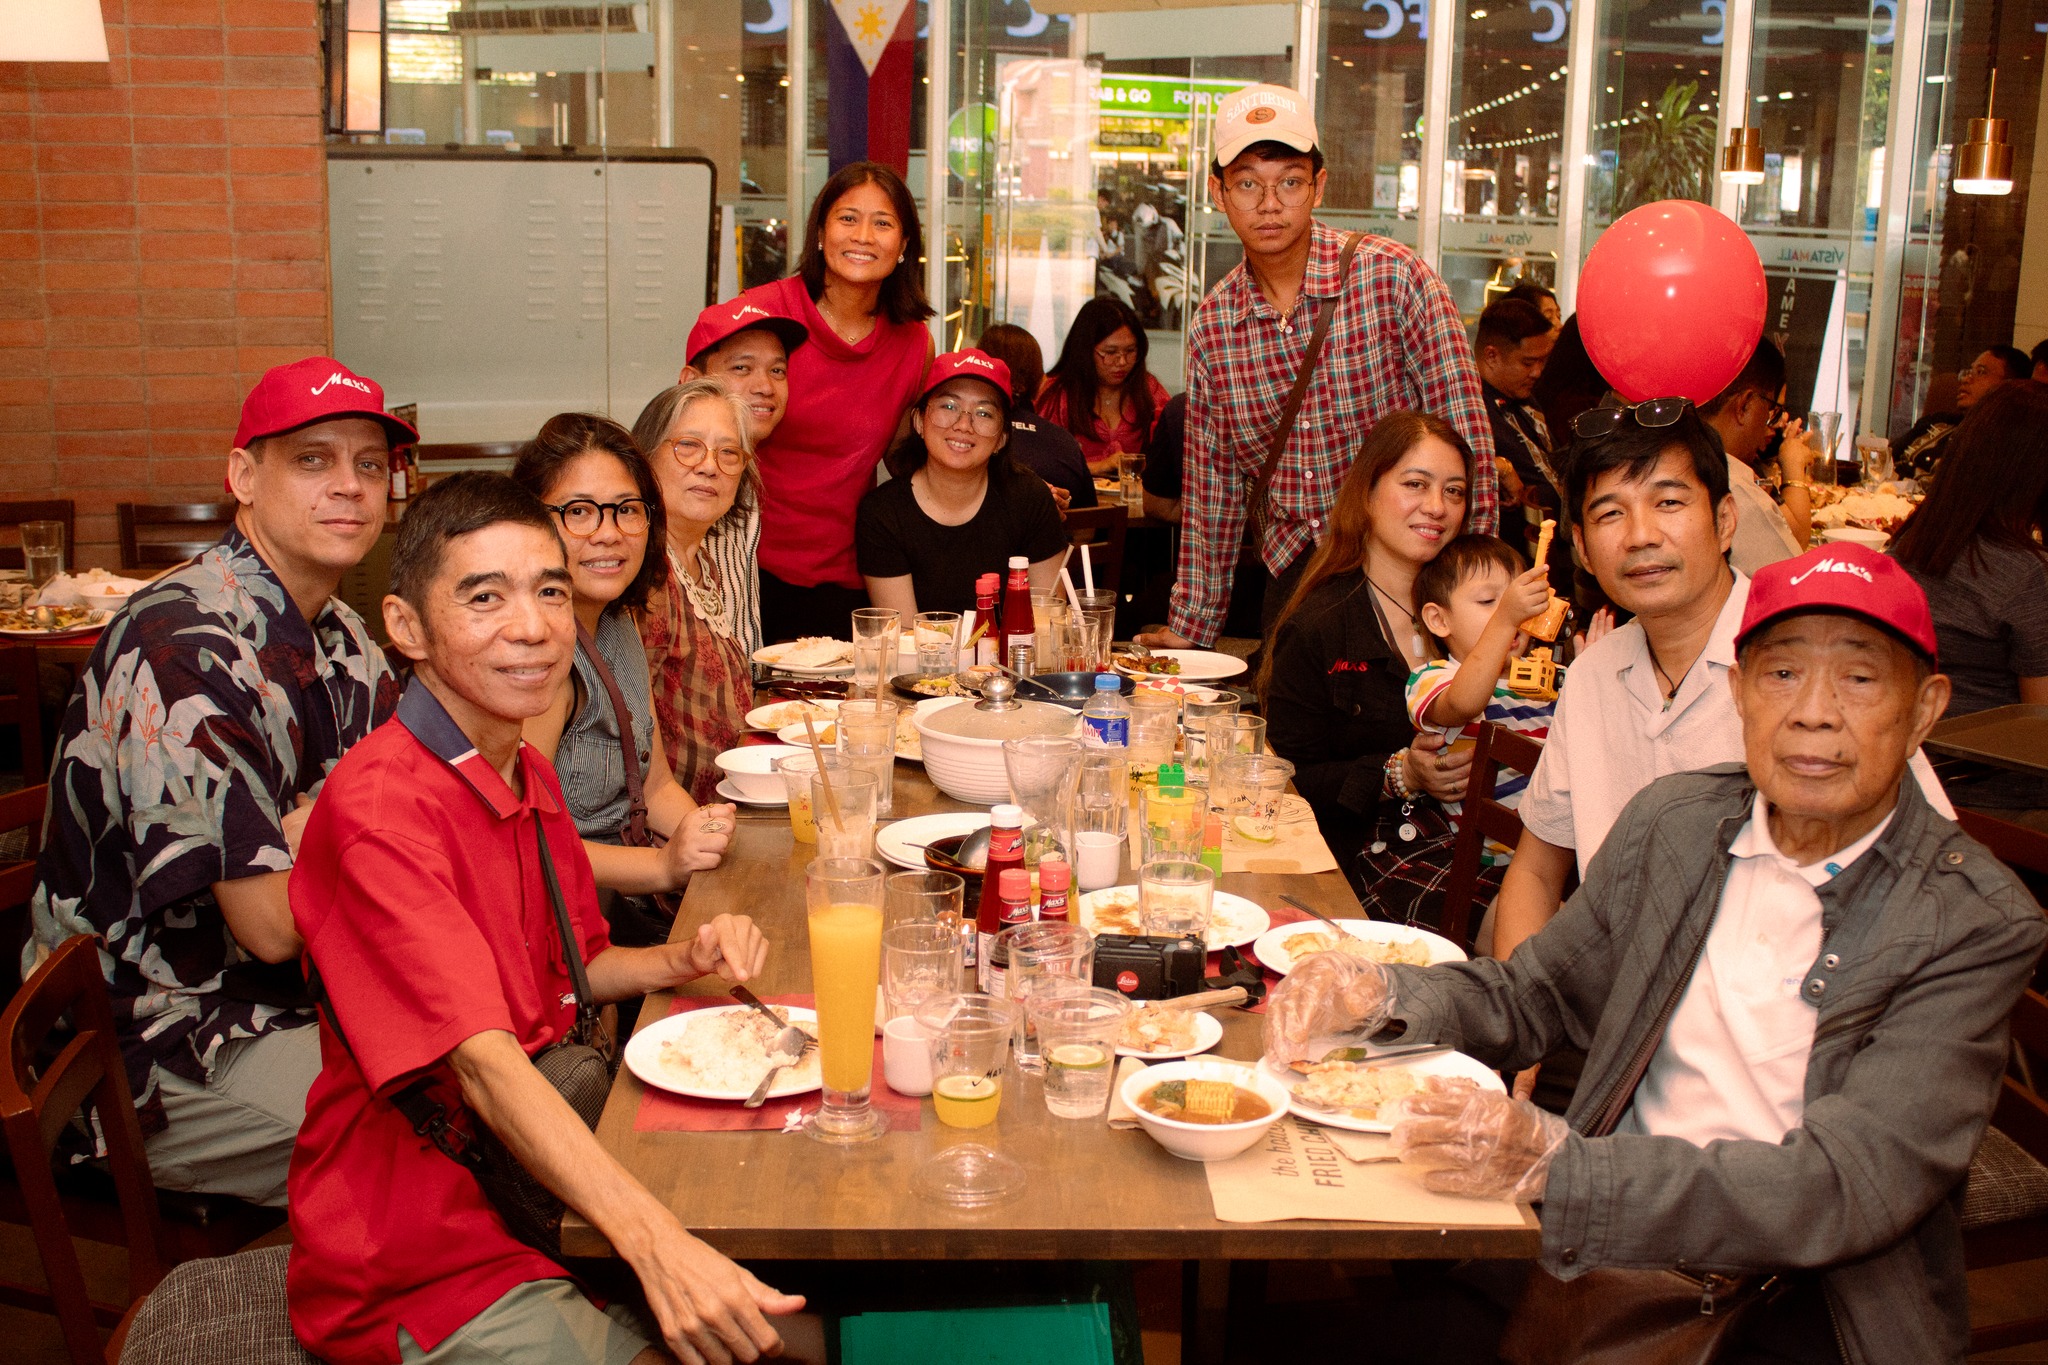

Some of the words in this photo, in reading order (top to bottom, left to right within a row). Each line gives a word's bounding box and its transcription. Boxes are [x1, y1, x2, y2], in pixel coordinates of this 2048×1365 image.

[1089, 86, 1114, 102] RAB
[1116, 87, 1127, 102] &
[1129, 88, 1151, 103] GO
[1226, 91, 1298, 124] SANTORINI
[953, 354, 994, 370] Max's
[310, 372, 372, 396] Max's
[1790, 557, 1875, 586] Max's
[1042, 896, 1067, 909] Max's
[1117, 975, 1138, 987] Leica
[1271, 1157, 1300, 1177] the
[1304, 1147, 1346, 1188] FRIED
